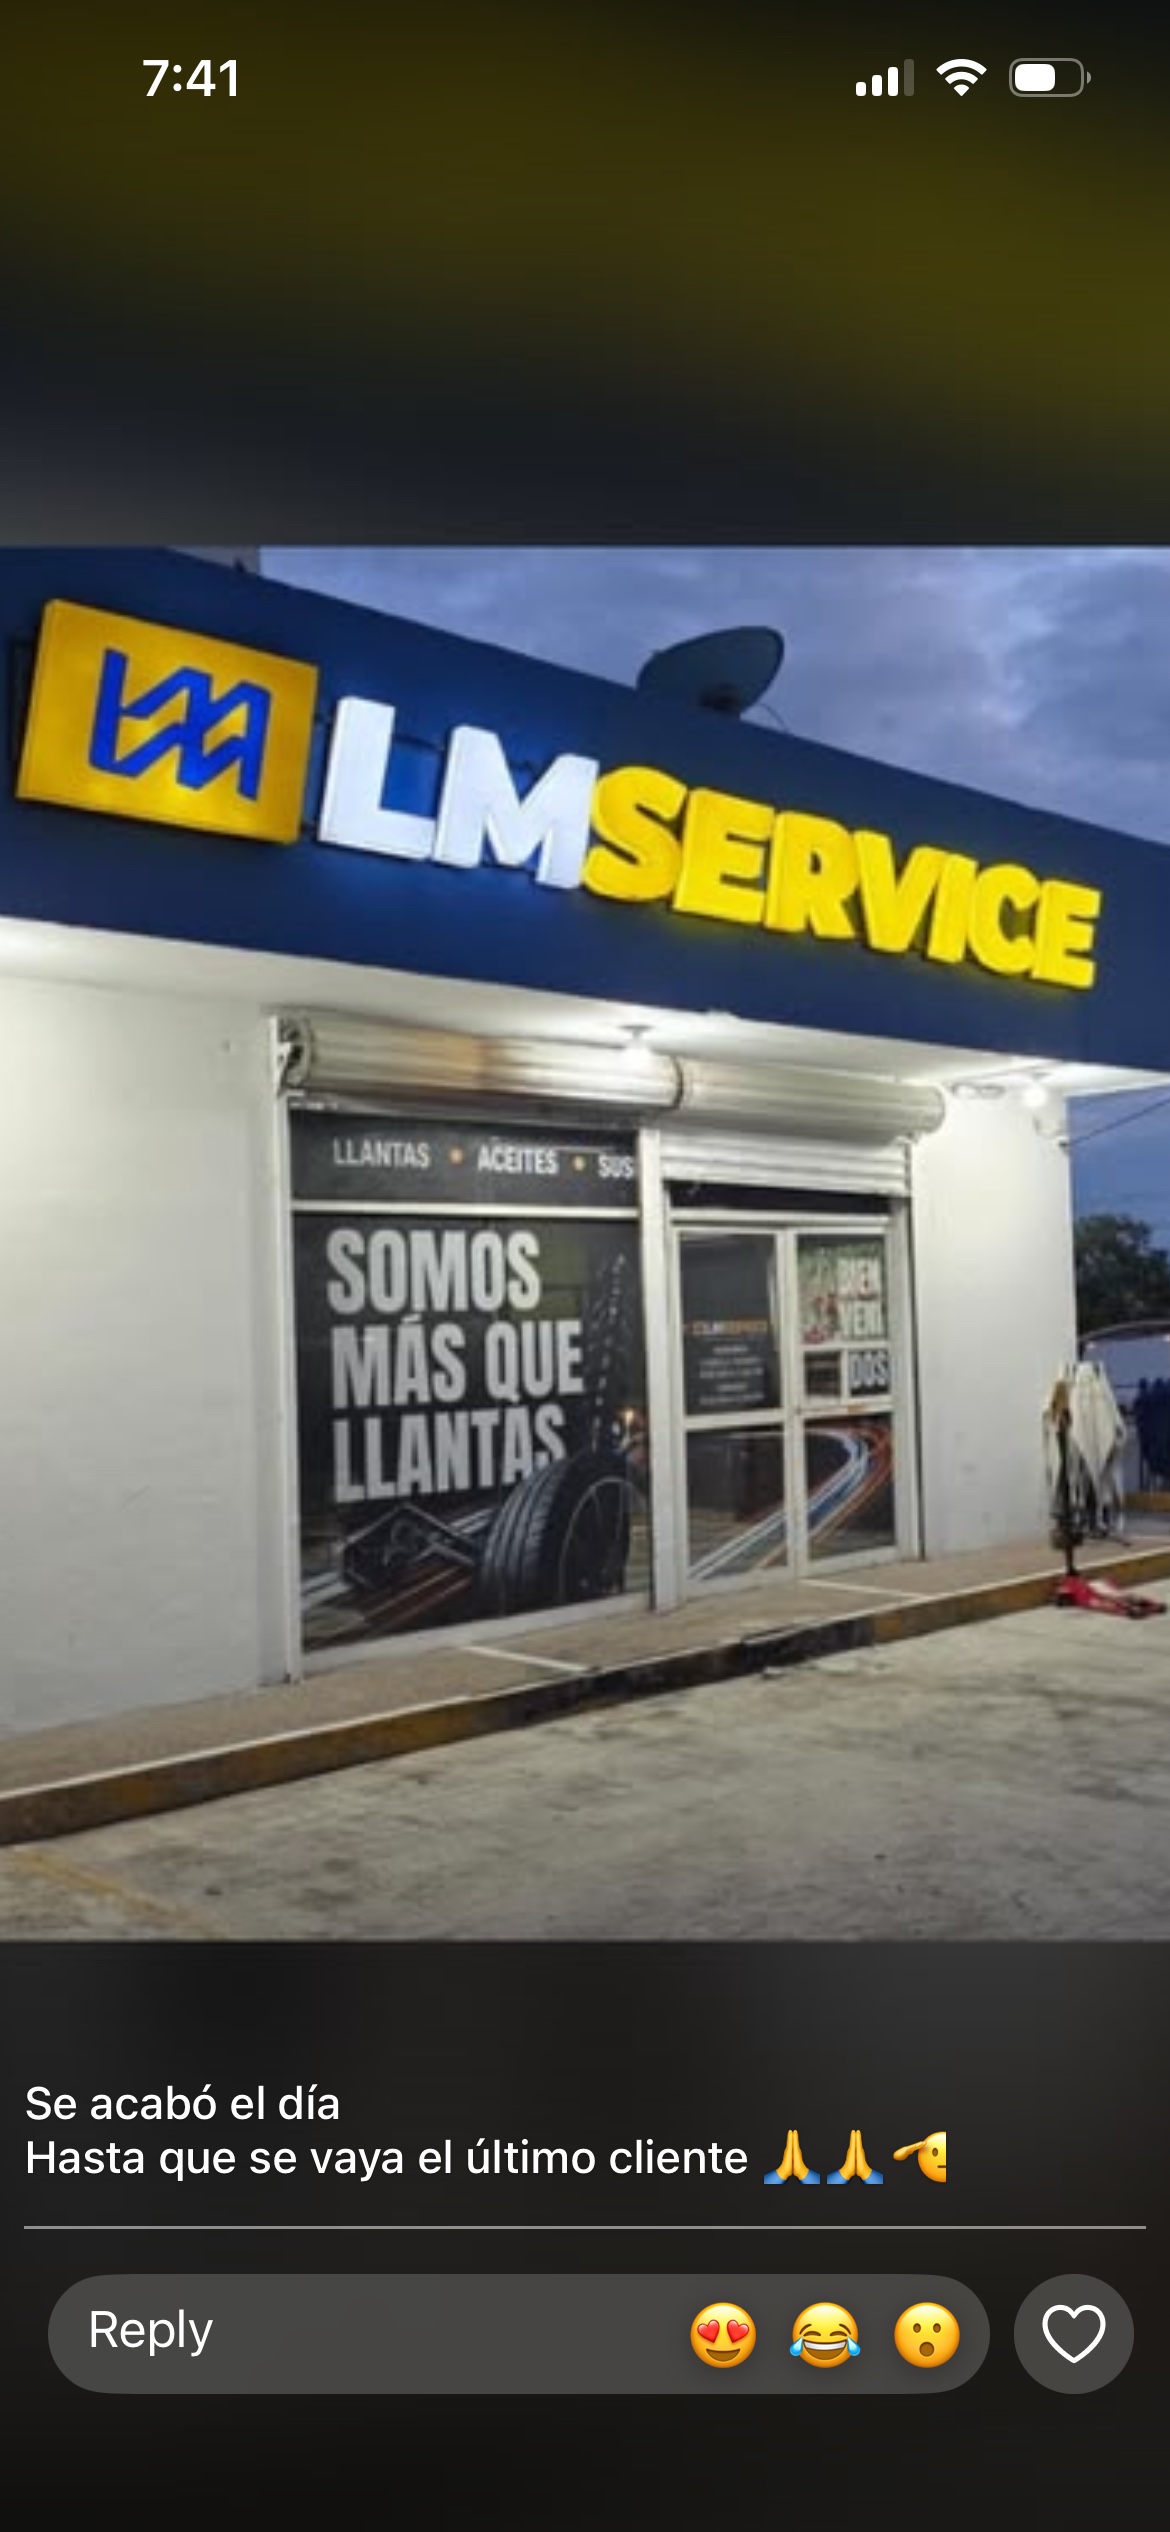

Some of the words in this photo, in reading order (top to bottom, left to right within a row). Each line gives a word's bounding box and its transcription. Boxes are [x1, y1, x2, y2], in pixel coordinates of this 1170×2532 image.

[333, 1139, 431, 1169] LLANTAS
[477, 1145, 559, 1175] ACEITES
[598, 1153, 635, 1179] SUS
[326, 1228, 541, 1315] SOMOS
[838, 1257, 883, 1297] BIEN
[840, 1300, 884, 1340] VENI
[332, 1313, 466, 1409] MÁS
[484, 1319, 584, 1404] QUE
[849, 1352, 888, 1389] DOS
[333, 1403, 567, 1503] LLANTAS
